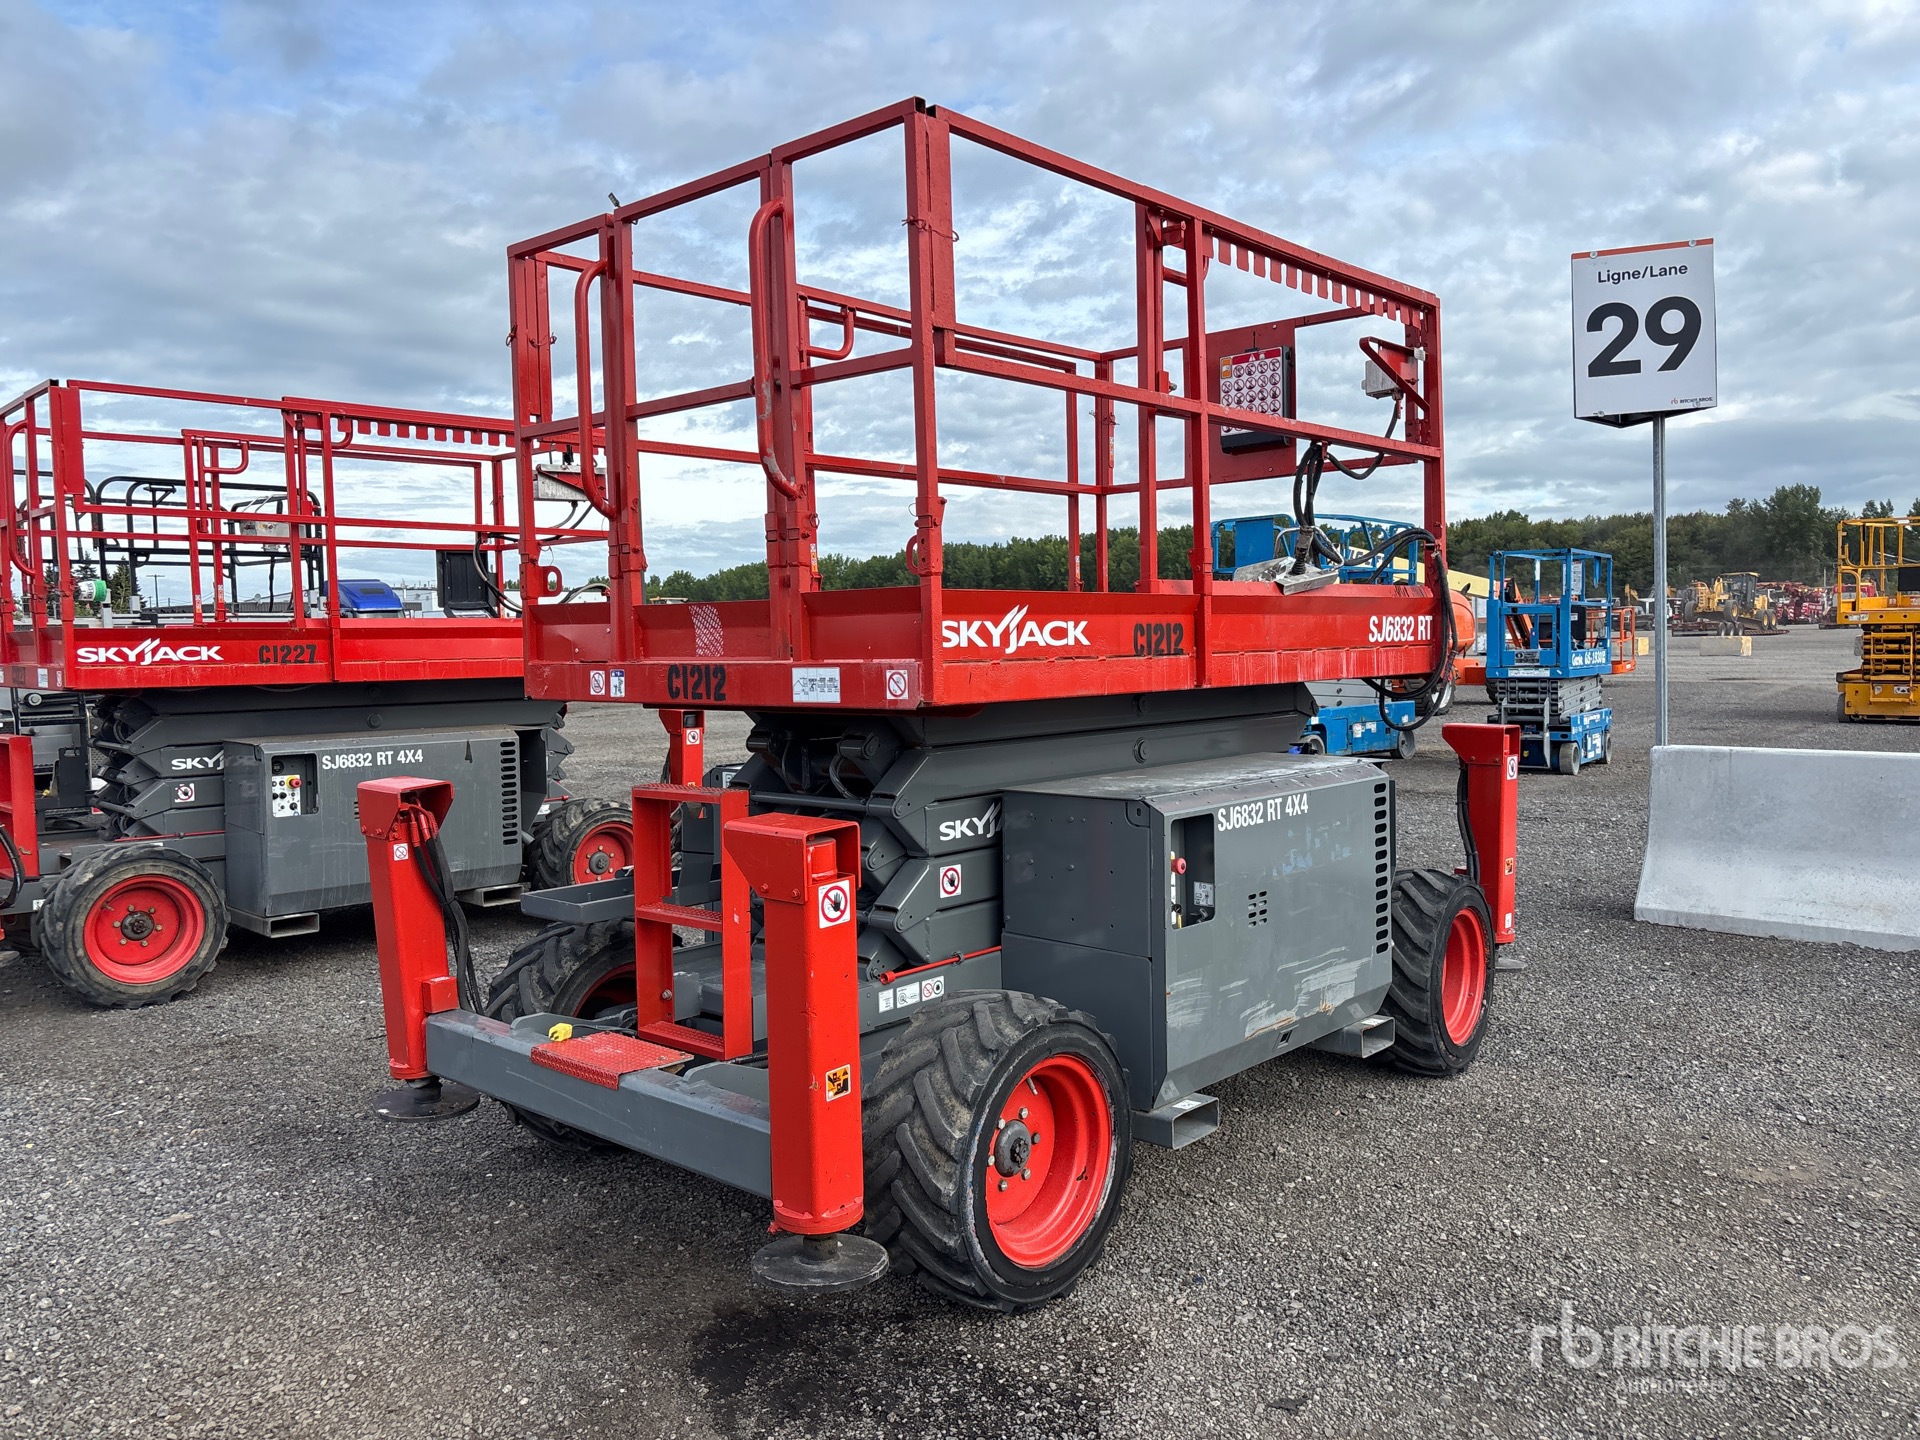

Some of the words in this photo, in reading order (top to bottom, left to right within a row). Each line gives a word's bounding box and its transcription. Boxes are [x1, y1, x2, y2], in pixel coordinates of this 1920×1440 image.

[1597, 264, 1688, 285] Ligne/Lane
[1586, 296, 1702, 378] 29
[942, 604, 1091, 654] SKYJACK
[1133, 622, 1184, 655] C1212
[1368, 615, 1415, 643] SJ6832
[1417, 615, 1433, 641] RT
[76, 637, 224, 666] SKYJACK
[258, 644, 317, 665] C1227
[667, 663, 727, 701] C1212
[171, 750, 225, 770] SKYJ
[321, 752, 373, 770] SJ6832
[376, 750, 394, 766] RT
[397, 748, 424, 764] 4X4
[939, 802, 1003, 842] SKYJ
[1217, 801, 1264, 832] SJ6832
[1267, 797, 1283, 822] RT
[1285, 793, 1309, 817] 4X4
